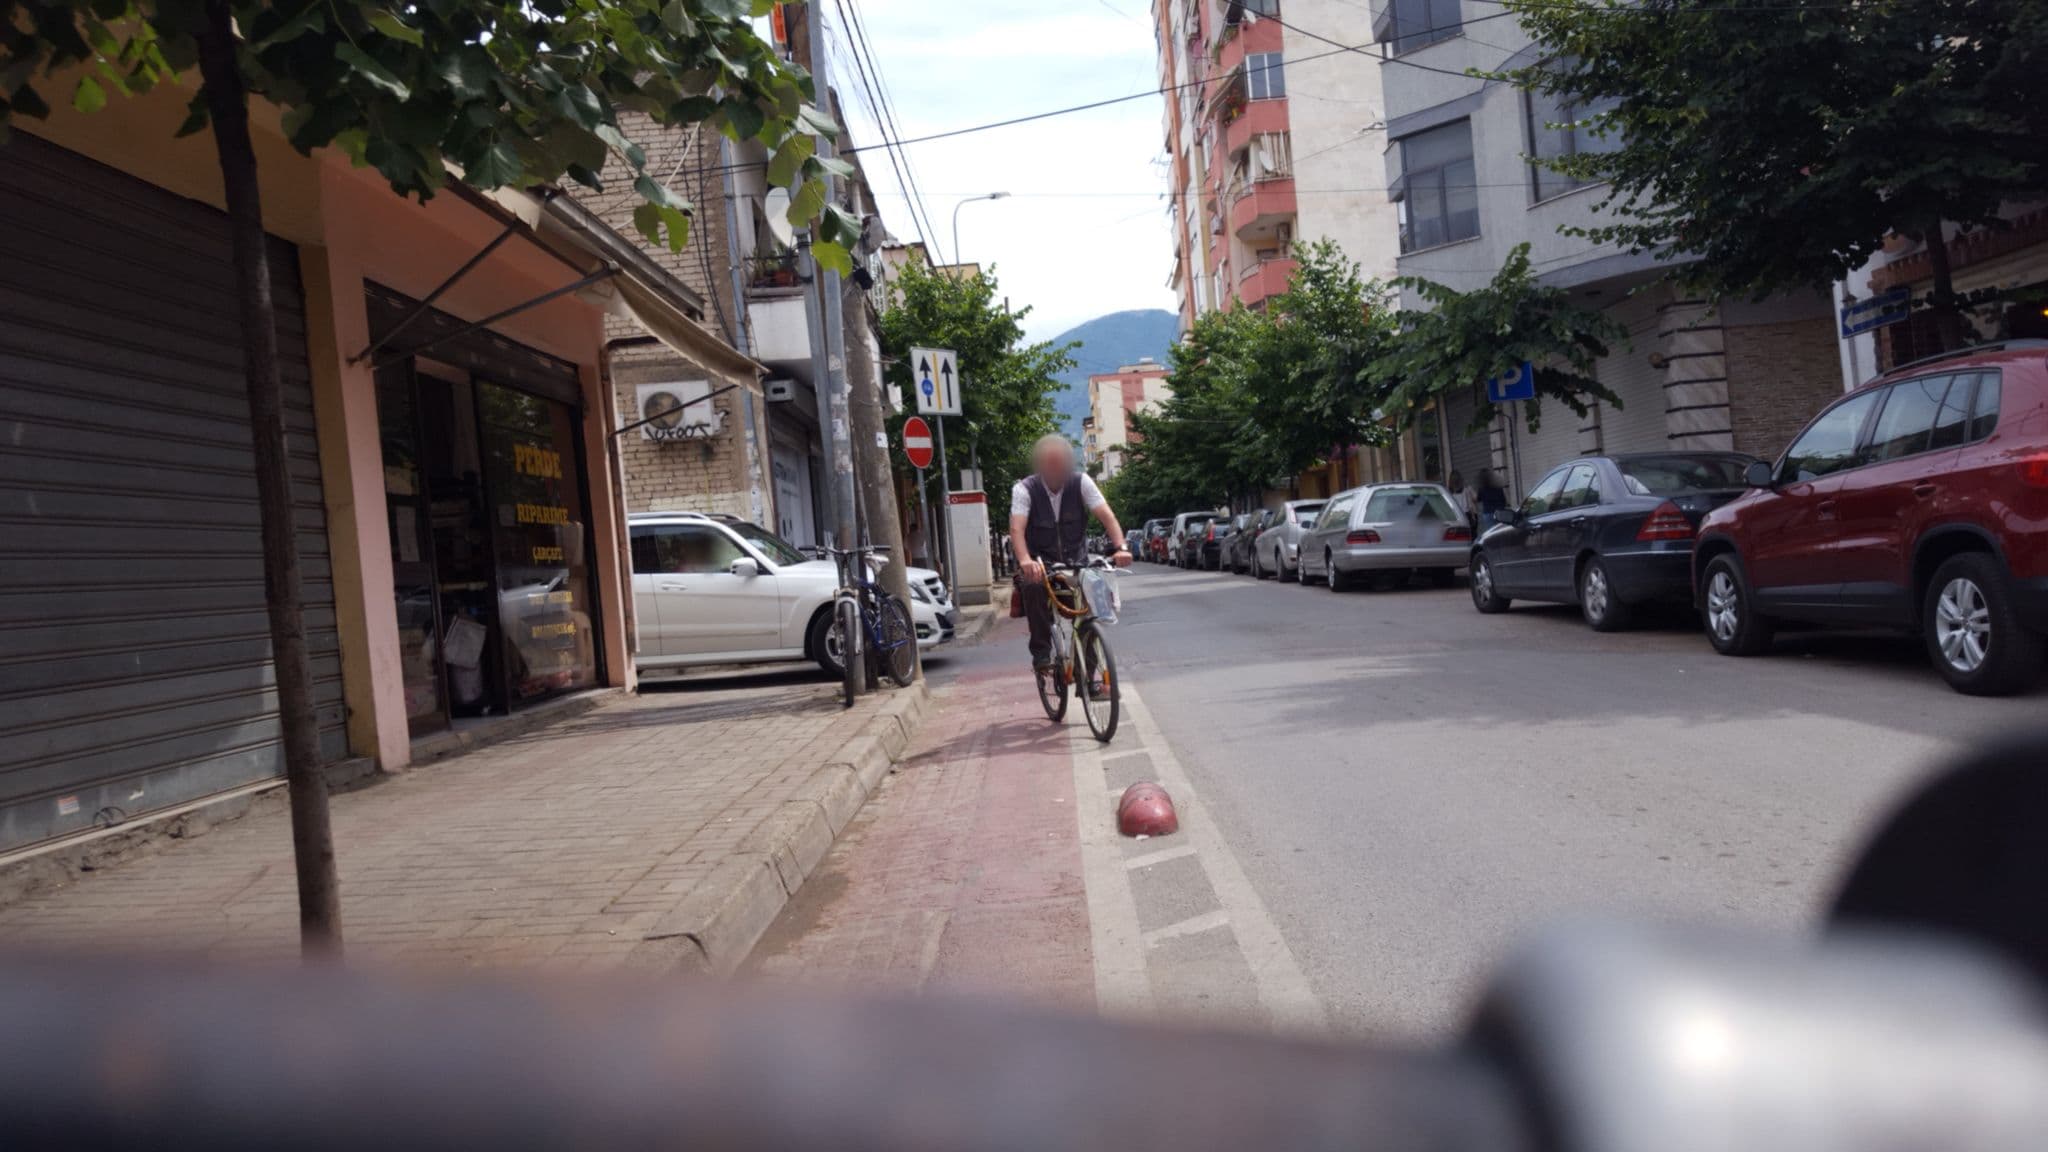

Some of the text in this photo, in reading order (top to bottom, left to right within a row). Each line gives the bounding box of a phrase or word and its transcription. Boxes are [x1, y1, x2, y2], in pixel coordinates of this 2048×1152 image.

[1497, 366, 1523, 398] P
[513, 443, 562, 480] PERDE
[516, 502, 569, 527] RIPARIME
